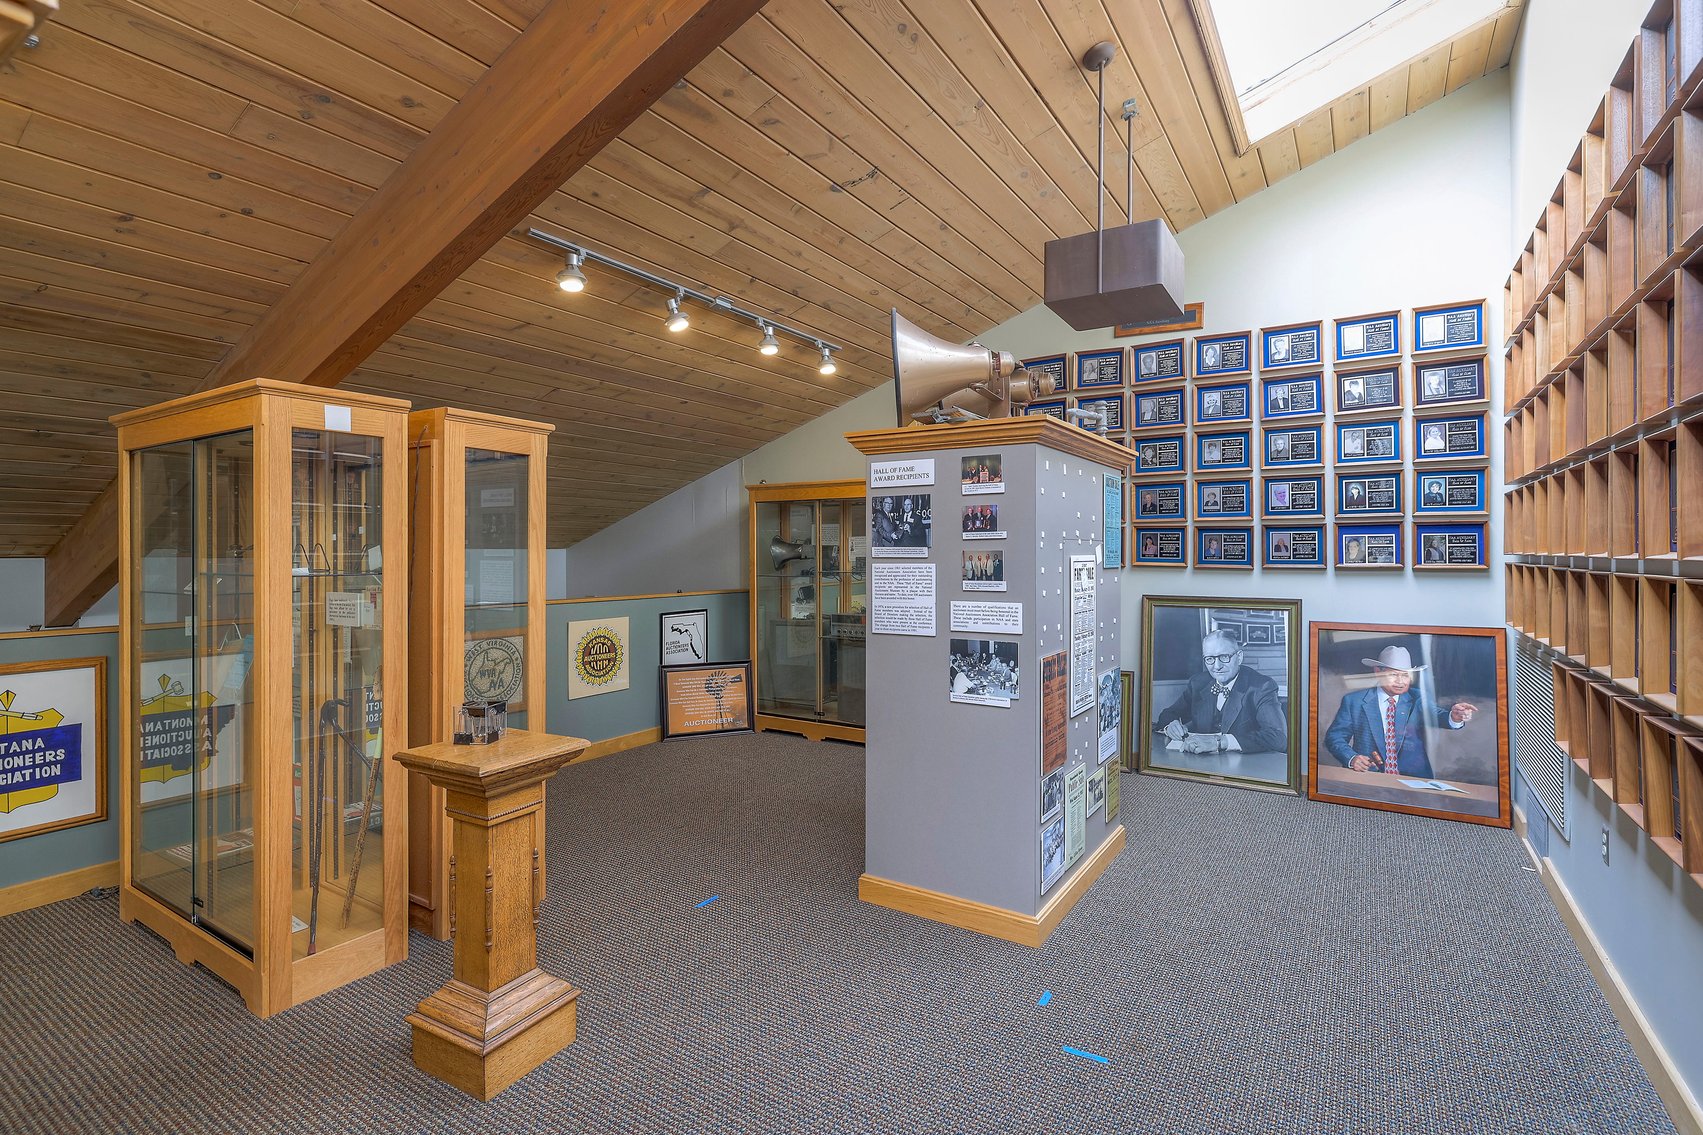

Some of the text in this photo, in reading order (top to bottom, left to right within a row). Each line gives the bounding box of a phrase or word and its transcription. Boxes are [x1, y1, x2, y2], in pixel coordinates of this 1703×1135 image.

[589, 638, 612, 648] KANSAS
[584, 652, 616, 664] AUCTIONEERS
[684, 717, 734, 727] AUCTIONEER
